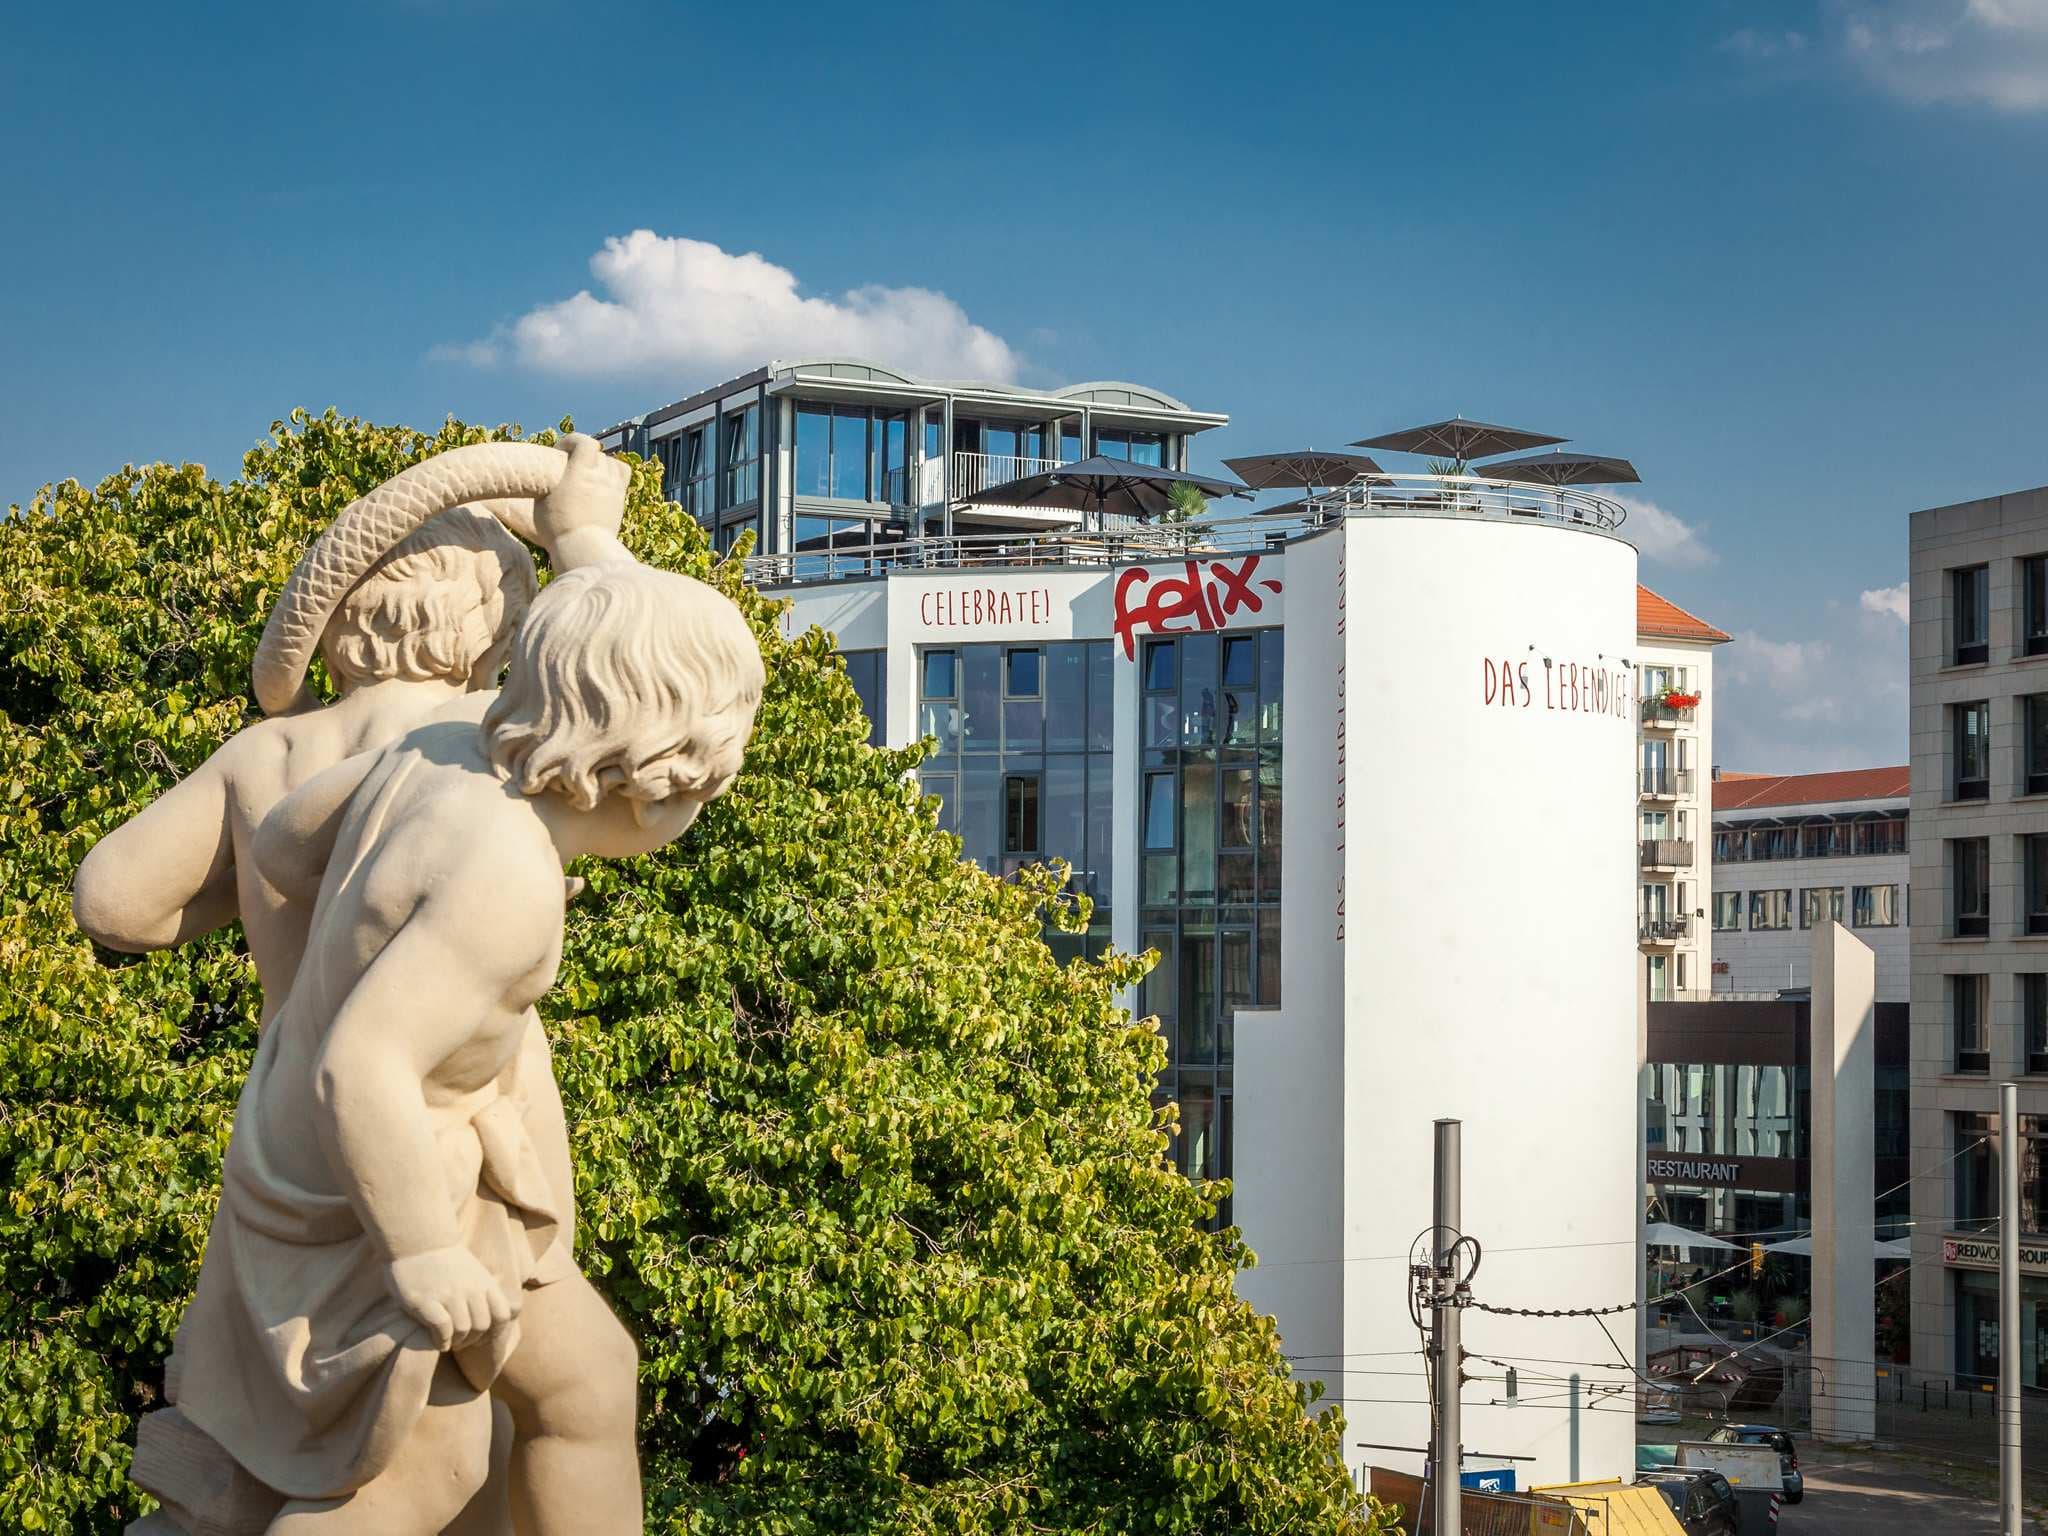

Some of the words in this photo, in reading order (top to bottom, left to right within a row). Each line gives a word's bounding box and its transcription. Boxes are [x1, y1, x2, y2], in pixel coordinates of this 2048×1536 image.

[921, 589, 1050, 626] CELEBRATE!
[1484, 657, 1531, 708] DAS
[1648, 1159, 1740, 1181] RESTAURANT
